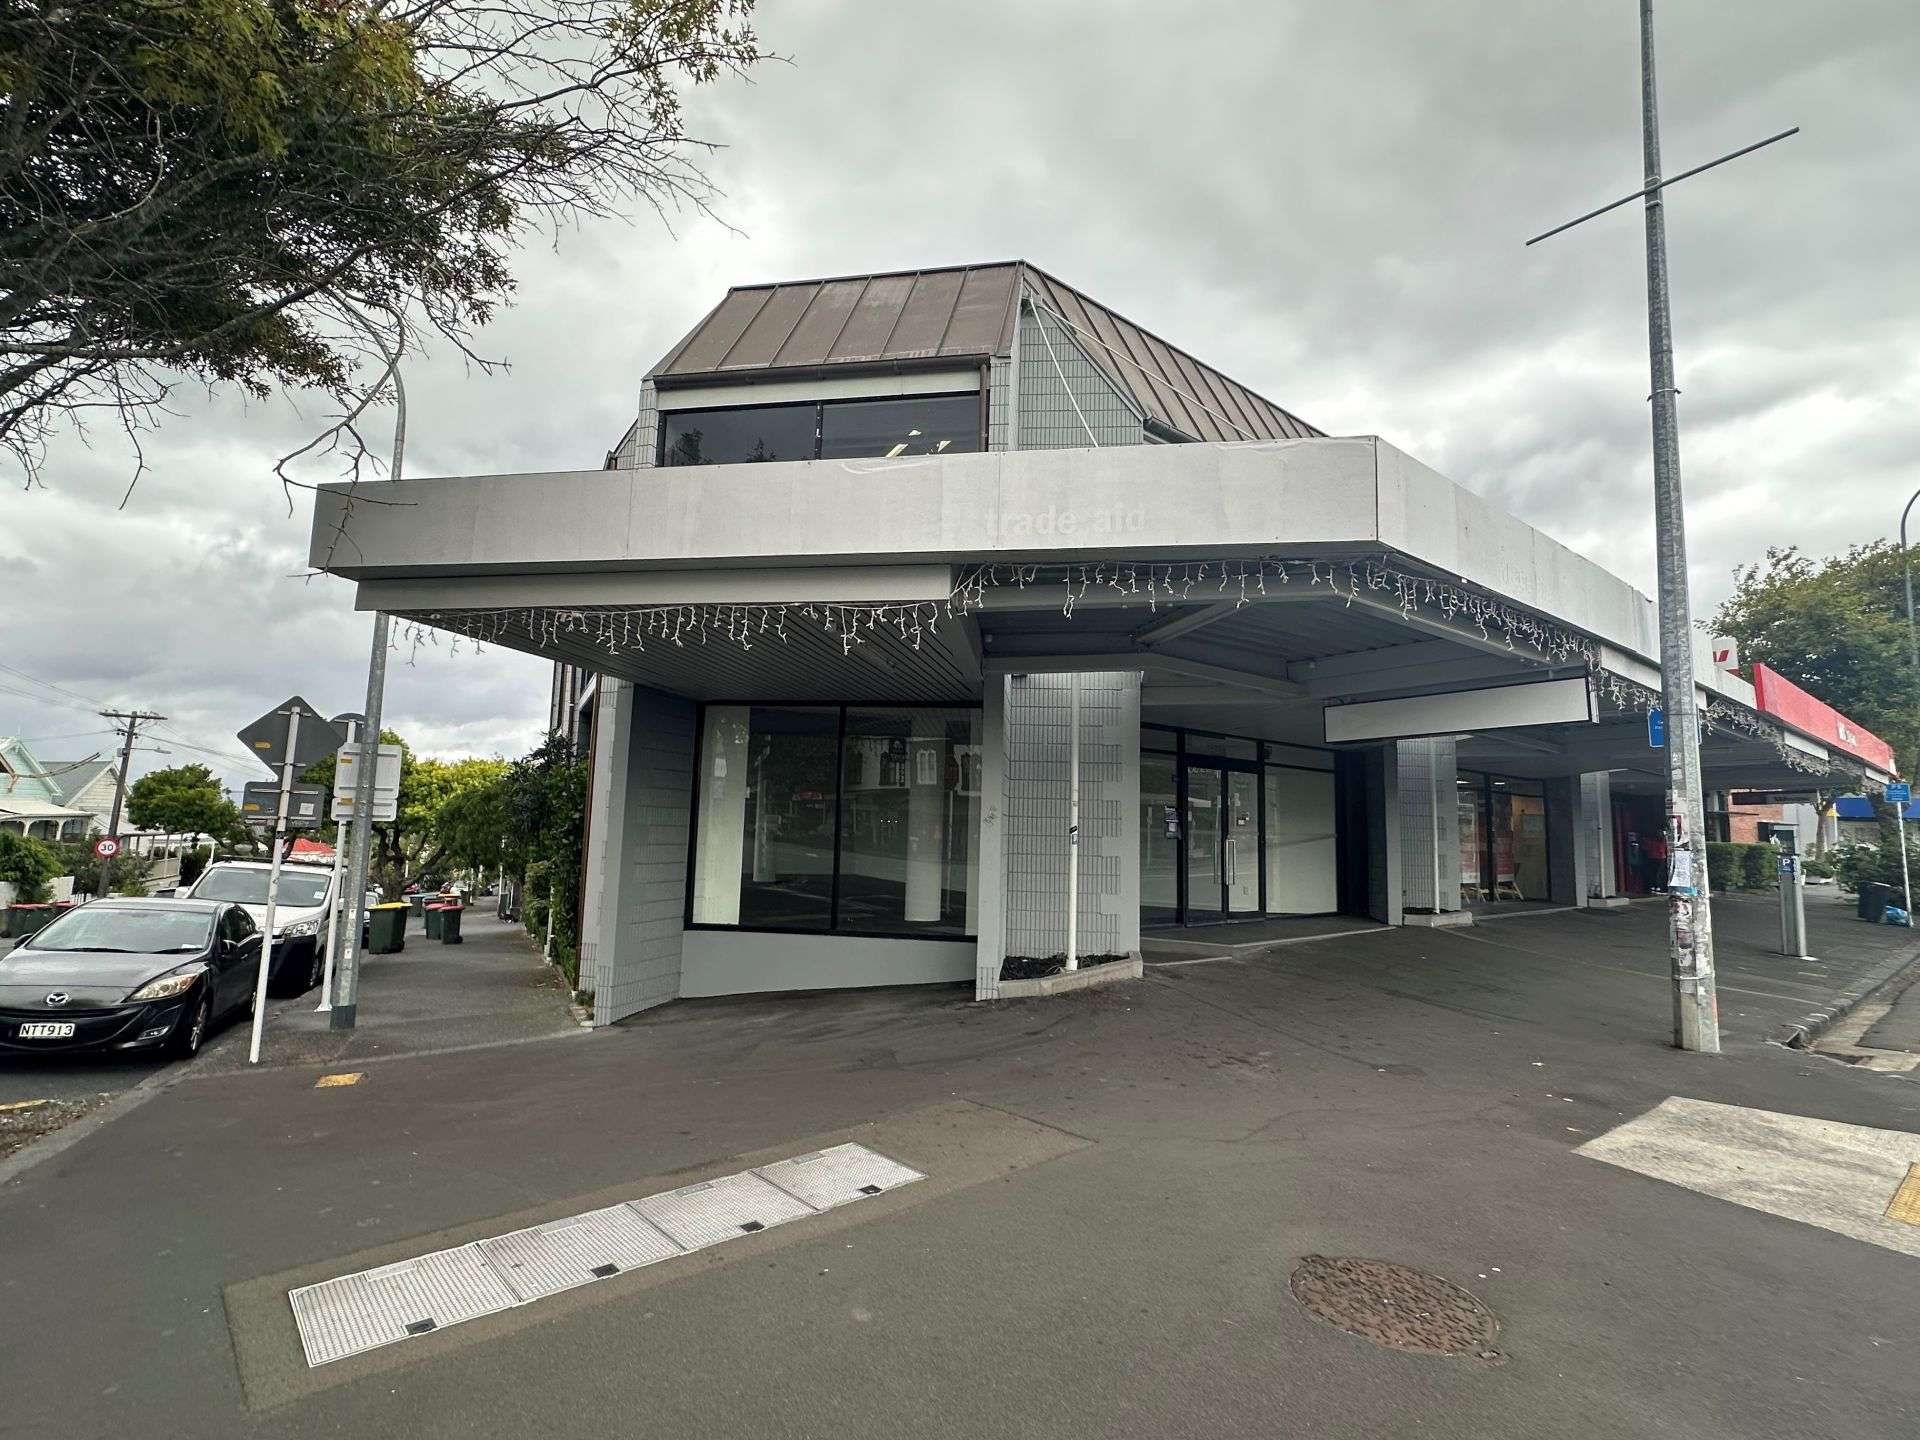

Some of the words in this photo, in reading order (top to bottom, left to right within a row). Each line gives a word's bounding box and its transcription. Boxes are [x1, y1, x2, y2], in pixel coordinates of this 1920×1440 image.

[984, 504, 1079, 536] trade
[1089, 501, 1146, 534] aid
[100, 843, 114, 852] 30
[21, 1024, 73, 1036] NTT913
